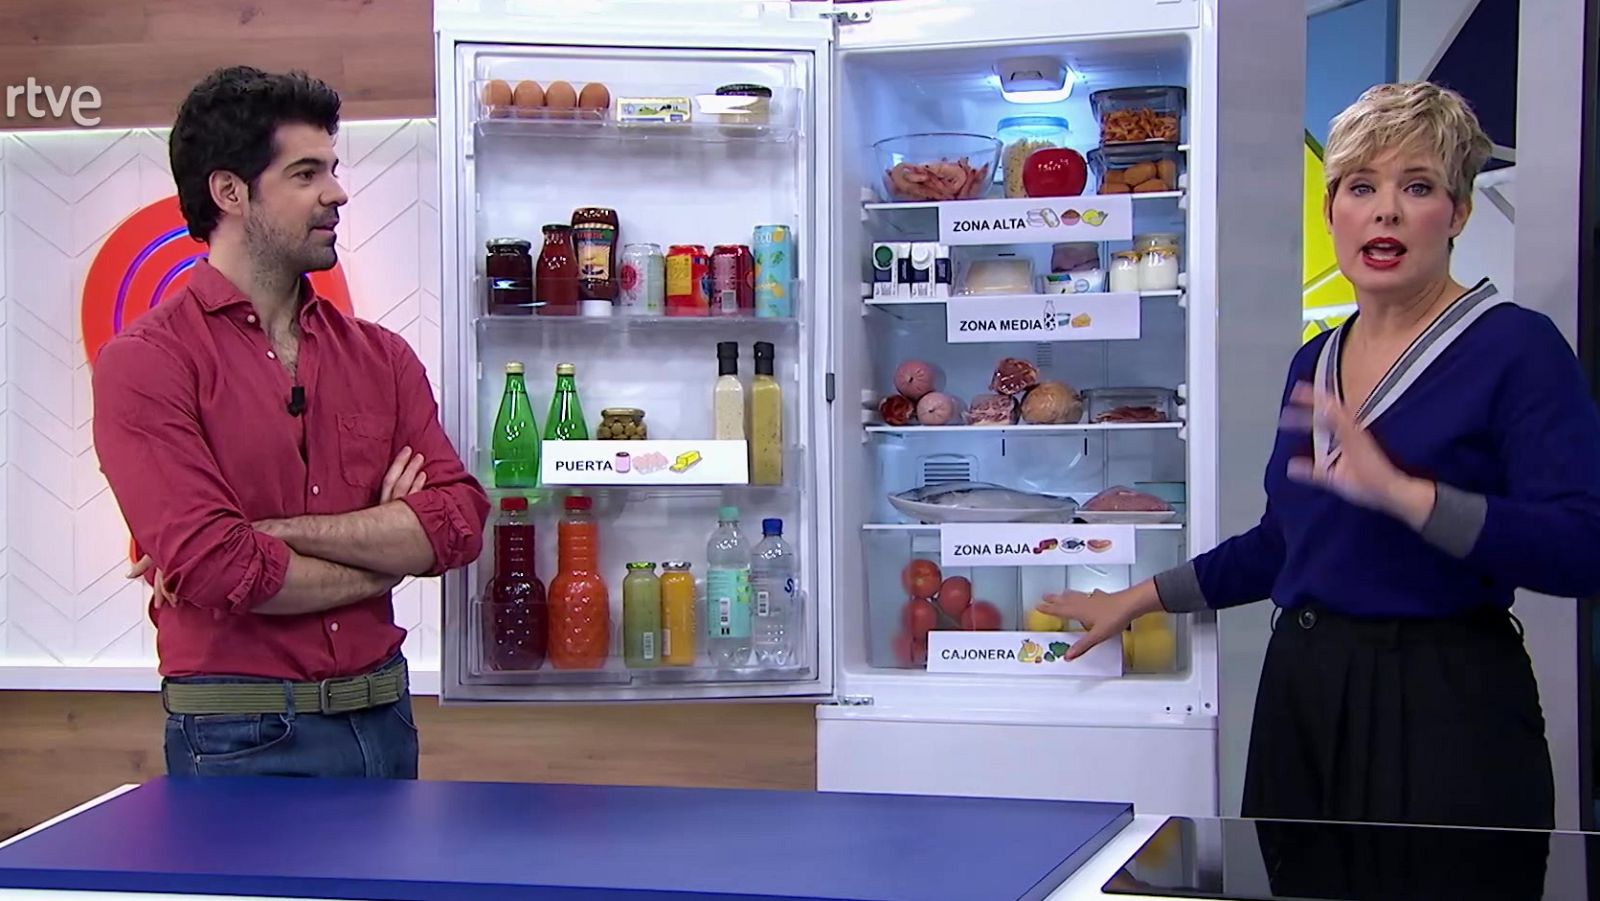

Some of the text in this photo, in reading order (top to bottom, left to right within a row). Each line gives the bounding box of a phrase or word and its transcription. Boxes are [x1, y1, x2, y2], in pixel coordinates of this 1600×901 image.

[953, 218, 1026, 232] ZONA ALTA
[959, 319, 1042, 332] ZONA MEDIA
[555, 460, 613, 472] PUERTA
[954, 543, 1031, 556] ZONA BAJA
[941, 649, 1015, 661] CAJONERA
